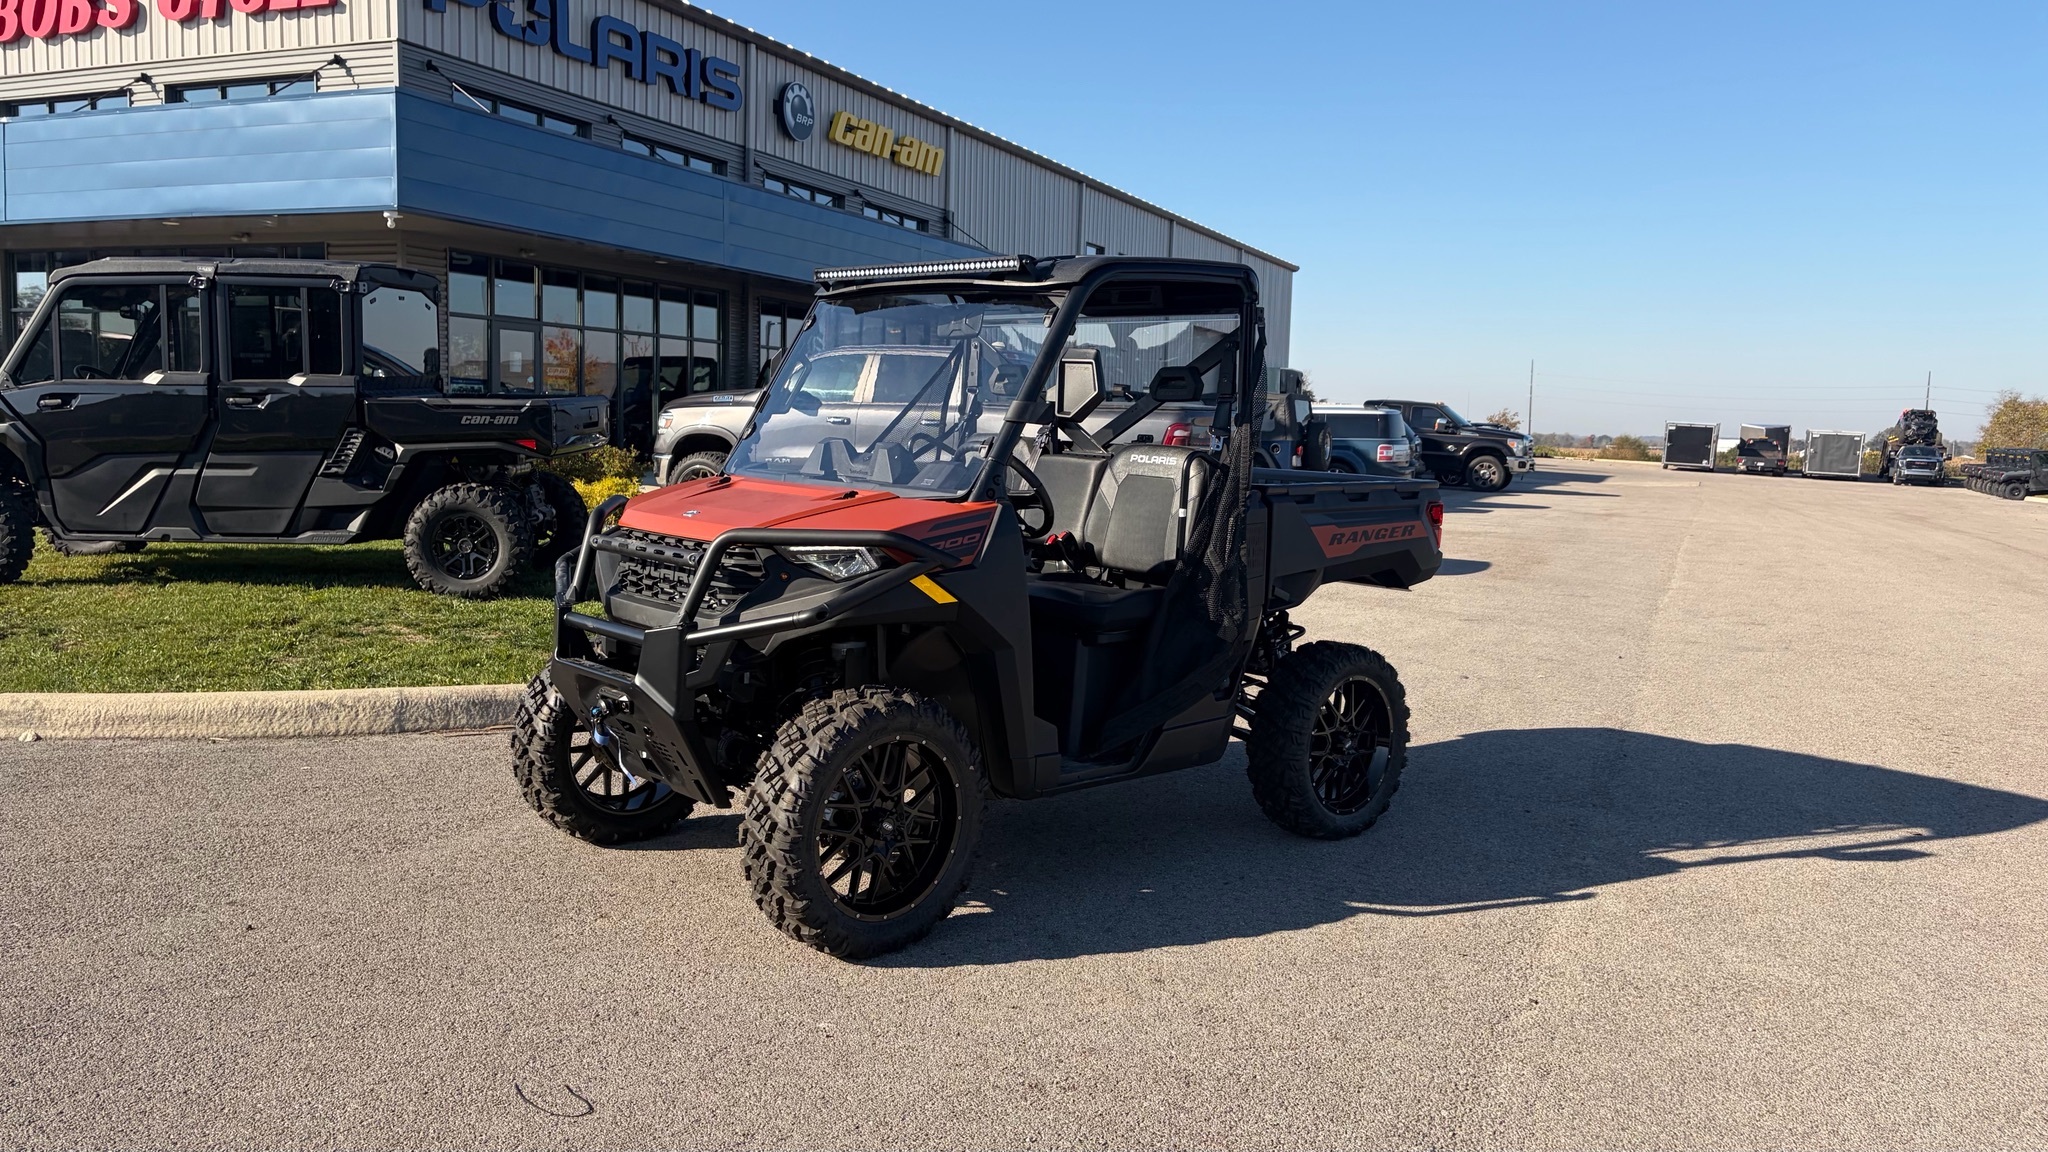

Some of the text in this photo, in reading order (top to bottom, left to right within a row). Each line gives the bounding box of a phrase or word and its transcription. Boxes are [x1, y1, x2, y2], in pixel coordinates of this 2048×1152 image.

[423, 0, 742, 112] OLARIS
[796, 113, 814, 127] BRP
[830, 111, 945, 177] can-am
[461, 415, 519, 425] can-am
[1130, 454, 1177, 465] POLARIS
[1328, 524, 1416, 546] RANGER
